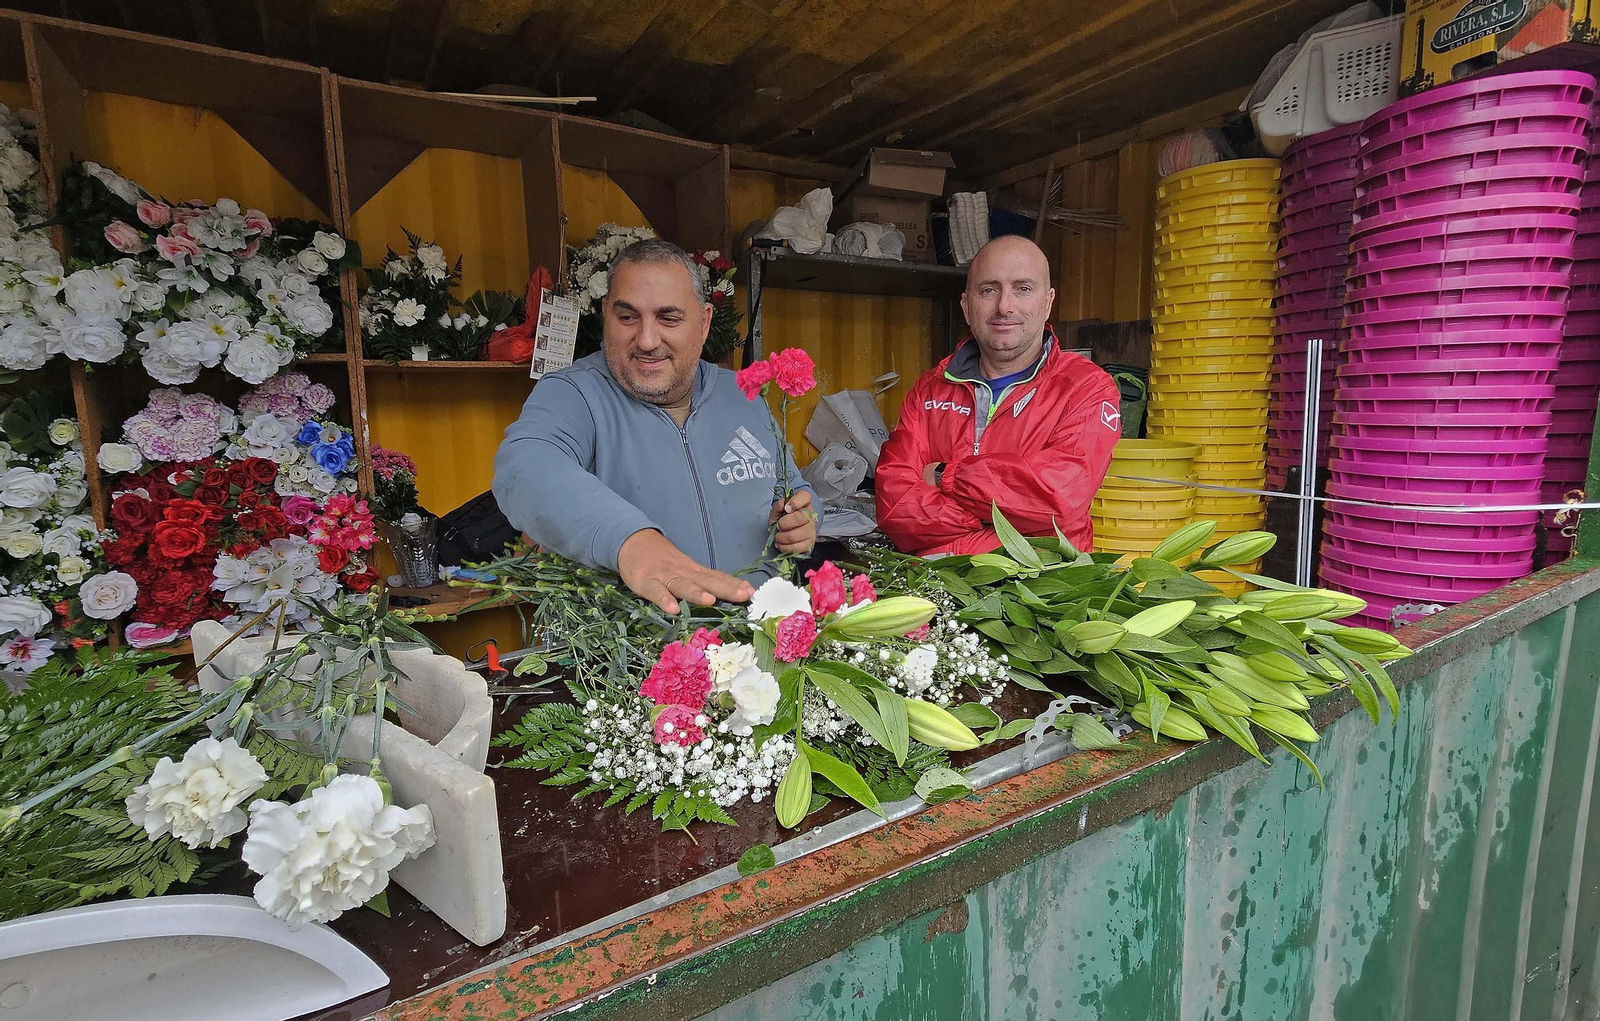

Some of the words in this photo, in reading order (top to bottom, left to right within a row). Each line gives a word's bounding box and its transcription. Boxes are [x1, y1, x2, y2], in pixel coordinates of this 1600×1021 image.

[1439, 14, 1488, 43] RIVERA,
[1490, 2, 1515, 23] S.L.
[1449, 26, 1502, 50] CHIPIONA
